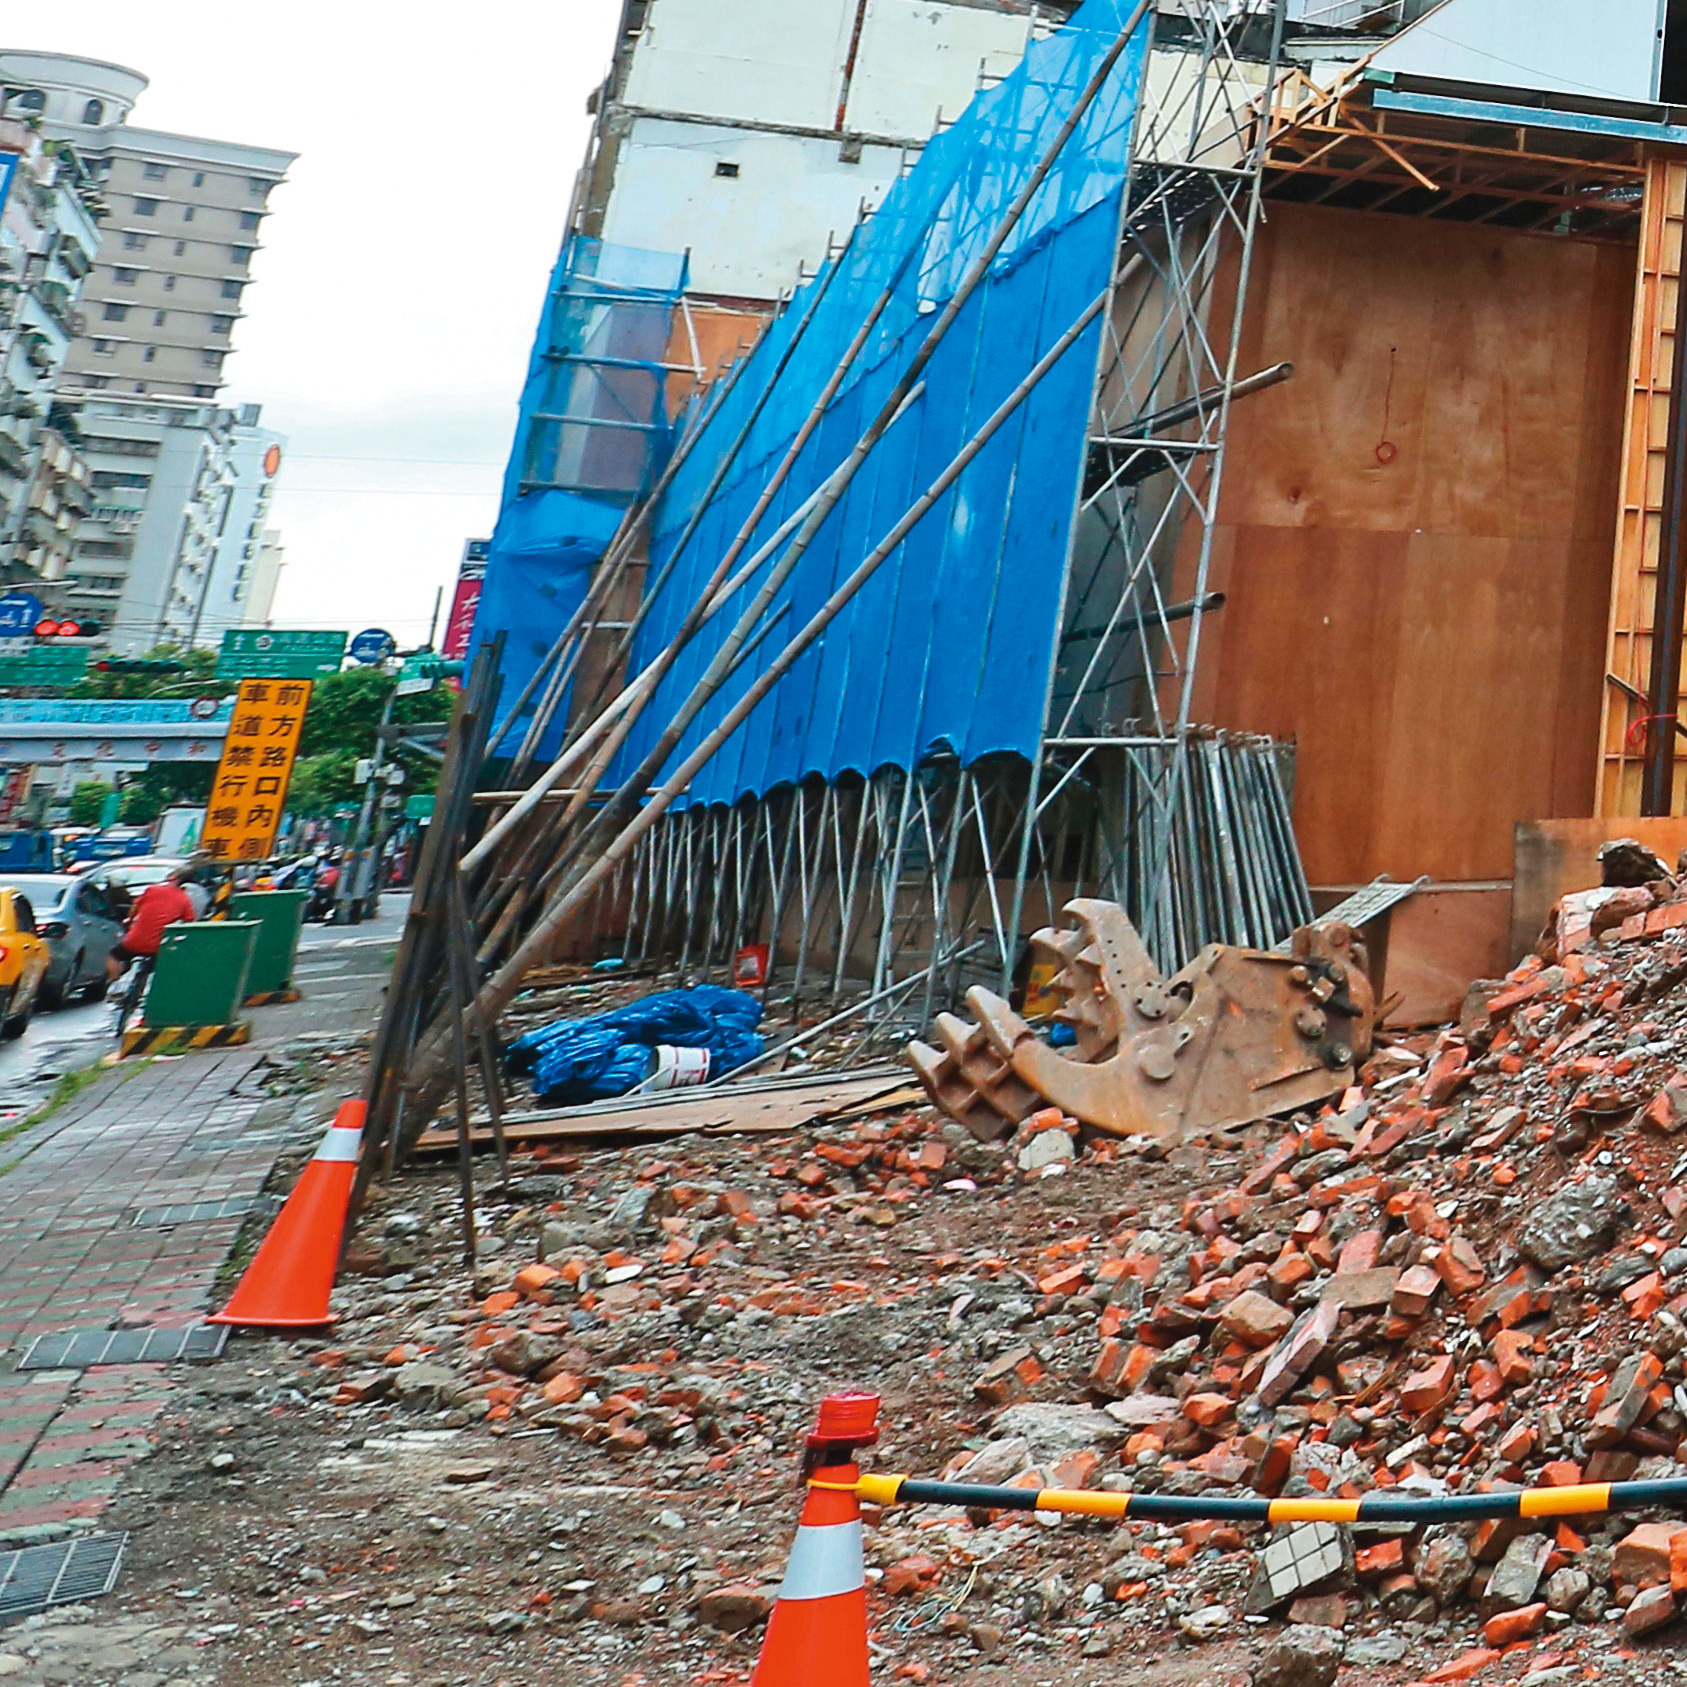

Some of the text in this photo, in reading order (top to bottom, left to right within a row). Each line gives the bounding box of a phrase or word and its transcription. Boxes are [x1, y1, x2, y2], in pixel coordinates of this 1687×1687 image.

[203, 682, 271, 858] 車道禁行機車
[237, 684, 305, 859] 前方路口內側
